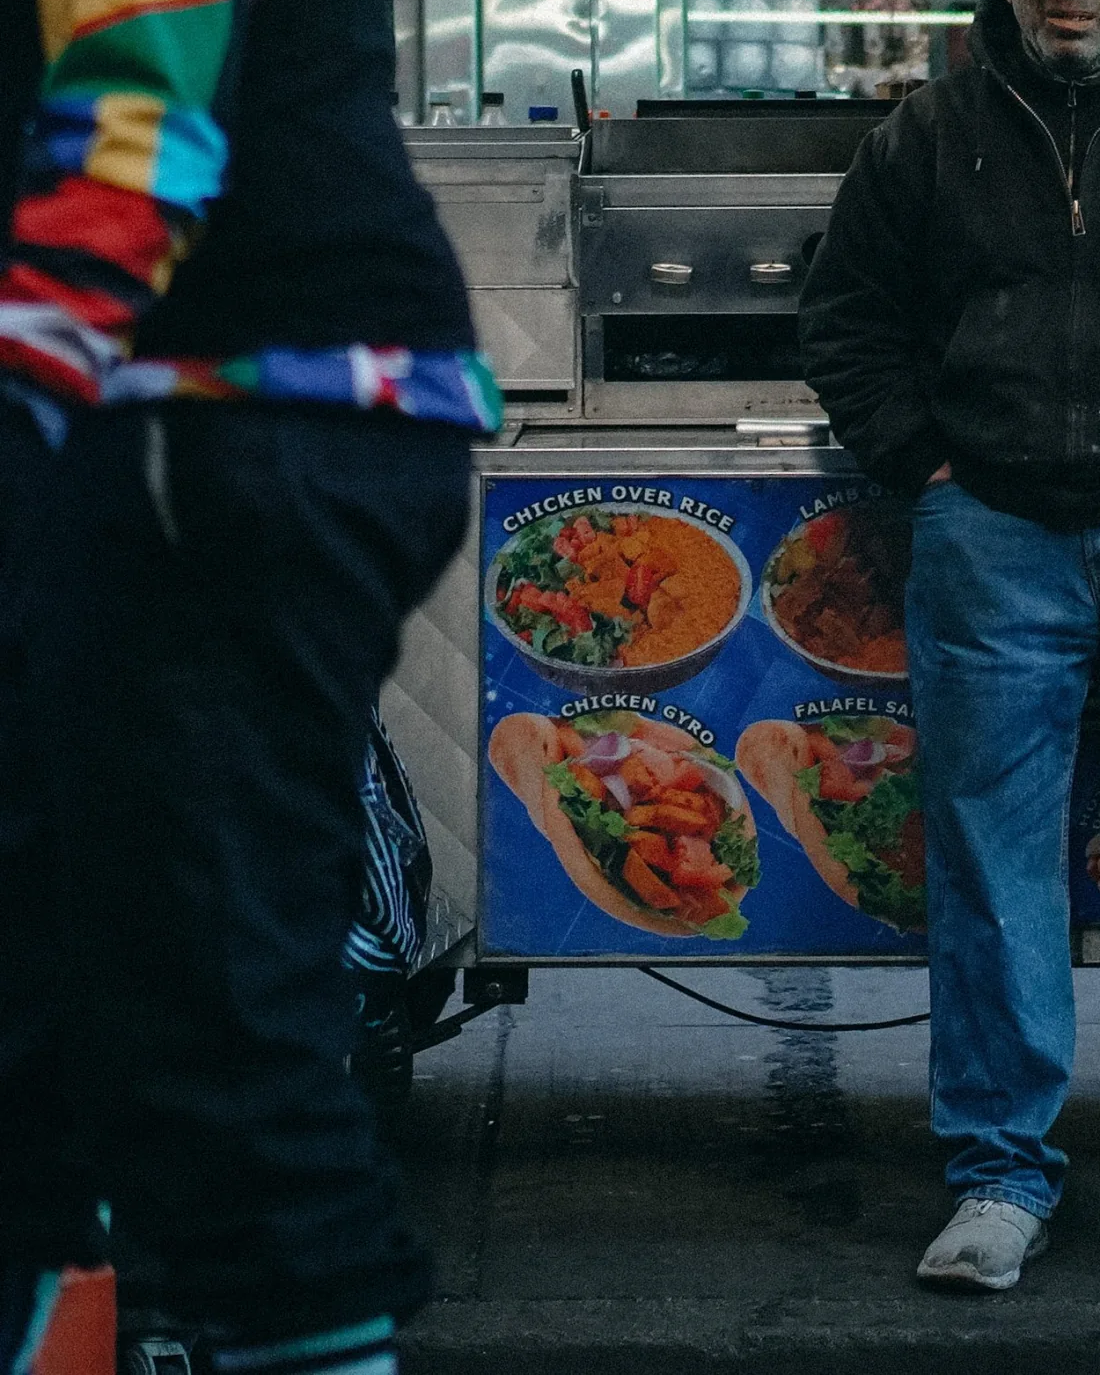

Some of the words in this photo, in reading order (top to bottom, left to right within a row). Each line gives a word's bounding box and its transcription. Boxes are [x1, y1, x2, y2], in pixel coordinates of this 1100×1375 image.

[501, 486, 604, 533] CHICKEN
[610, 484, 673, 507] OVER
[678, 495, 735, 532] RICE
[798, 487, 860, 520] LAMB
[560, 693, 658, 718] CHICKEN
[661, 704, 716, 747] GYRO
[793, 696, 878, 720] FALAFEL
